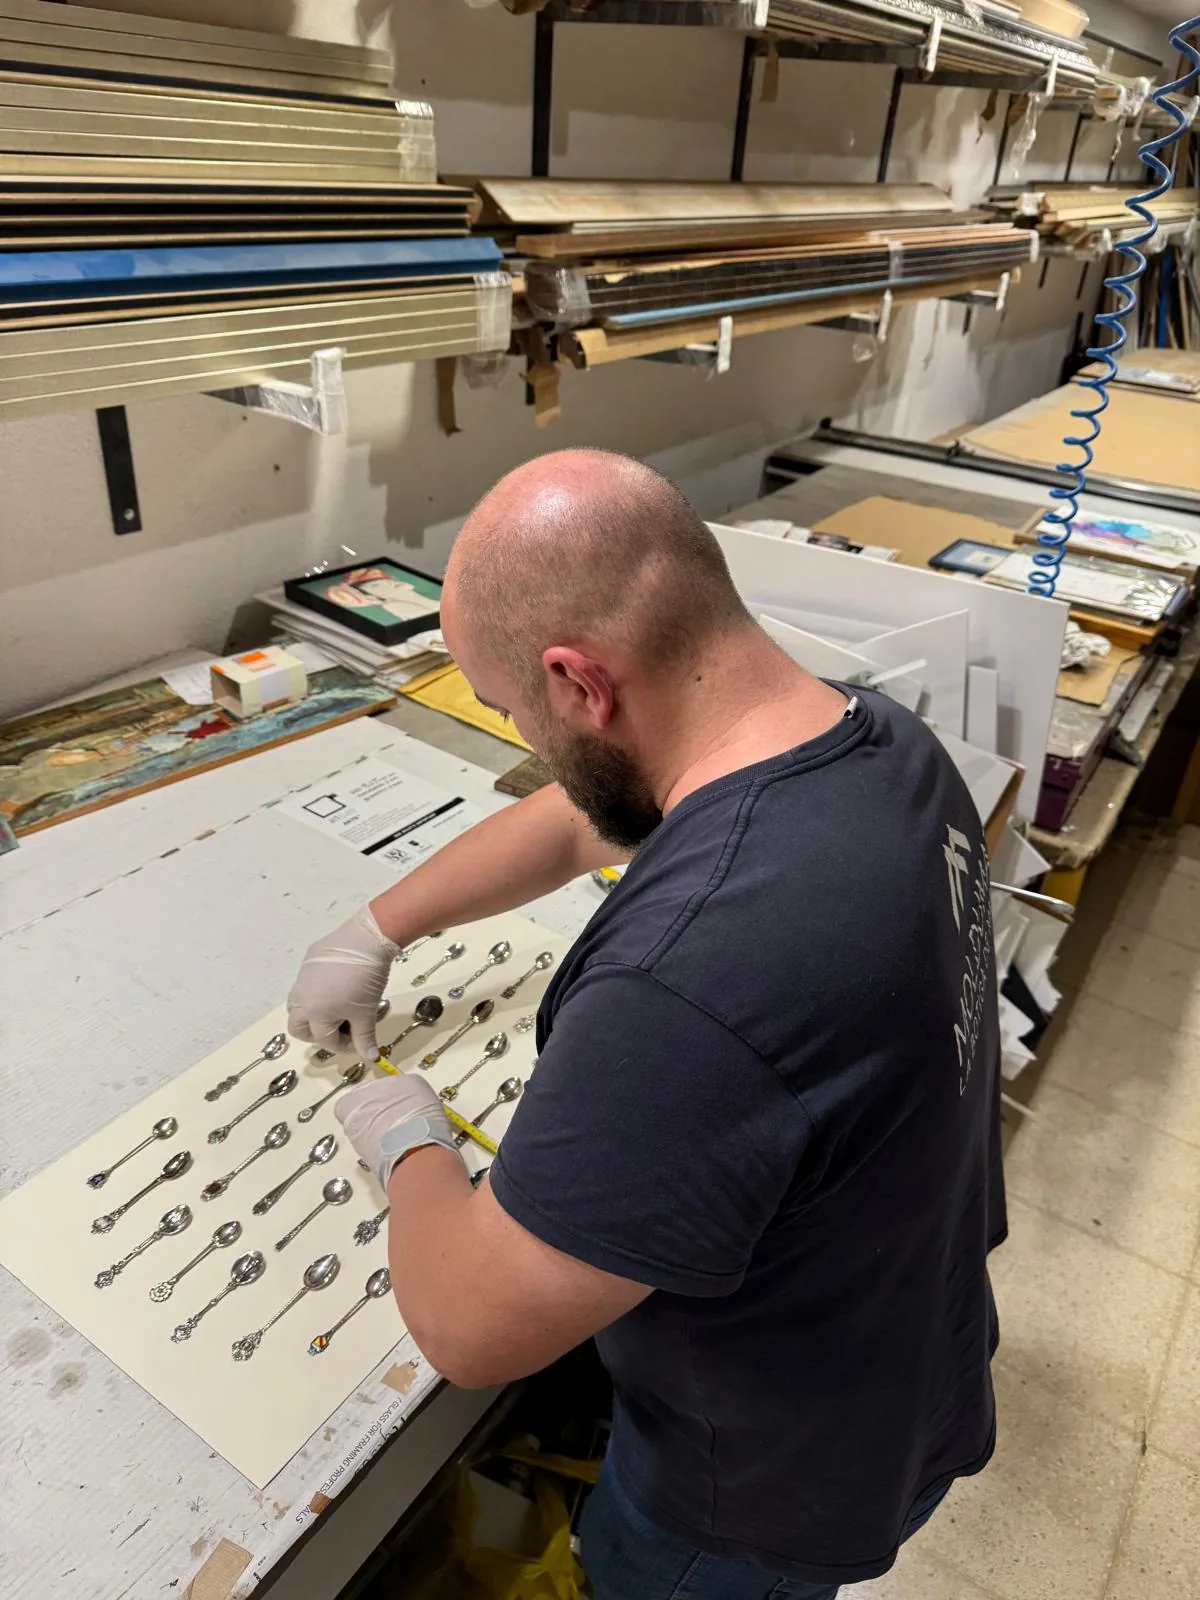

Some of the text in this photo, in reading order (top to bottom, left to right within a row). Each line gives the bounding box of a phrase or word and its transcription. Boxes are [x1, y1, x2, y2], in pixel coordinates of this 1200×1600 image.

[379, 1400, 400, 1424] GLASS
[367, 1420, 382, 1437] FOR
[343, 1434, 372, 1467] FRAMING
[294, 1465, 345, 1525] PROFESALS
